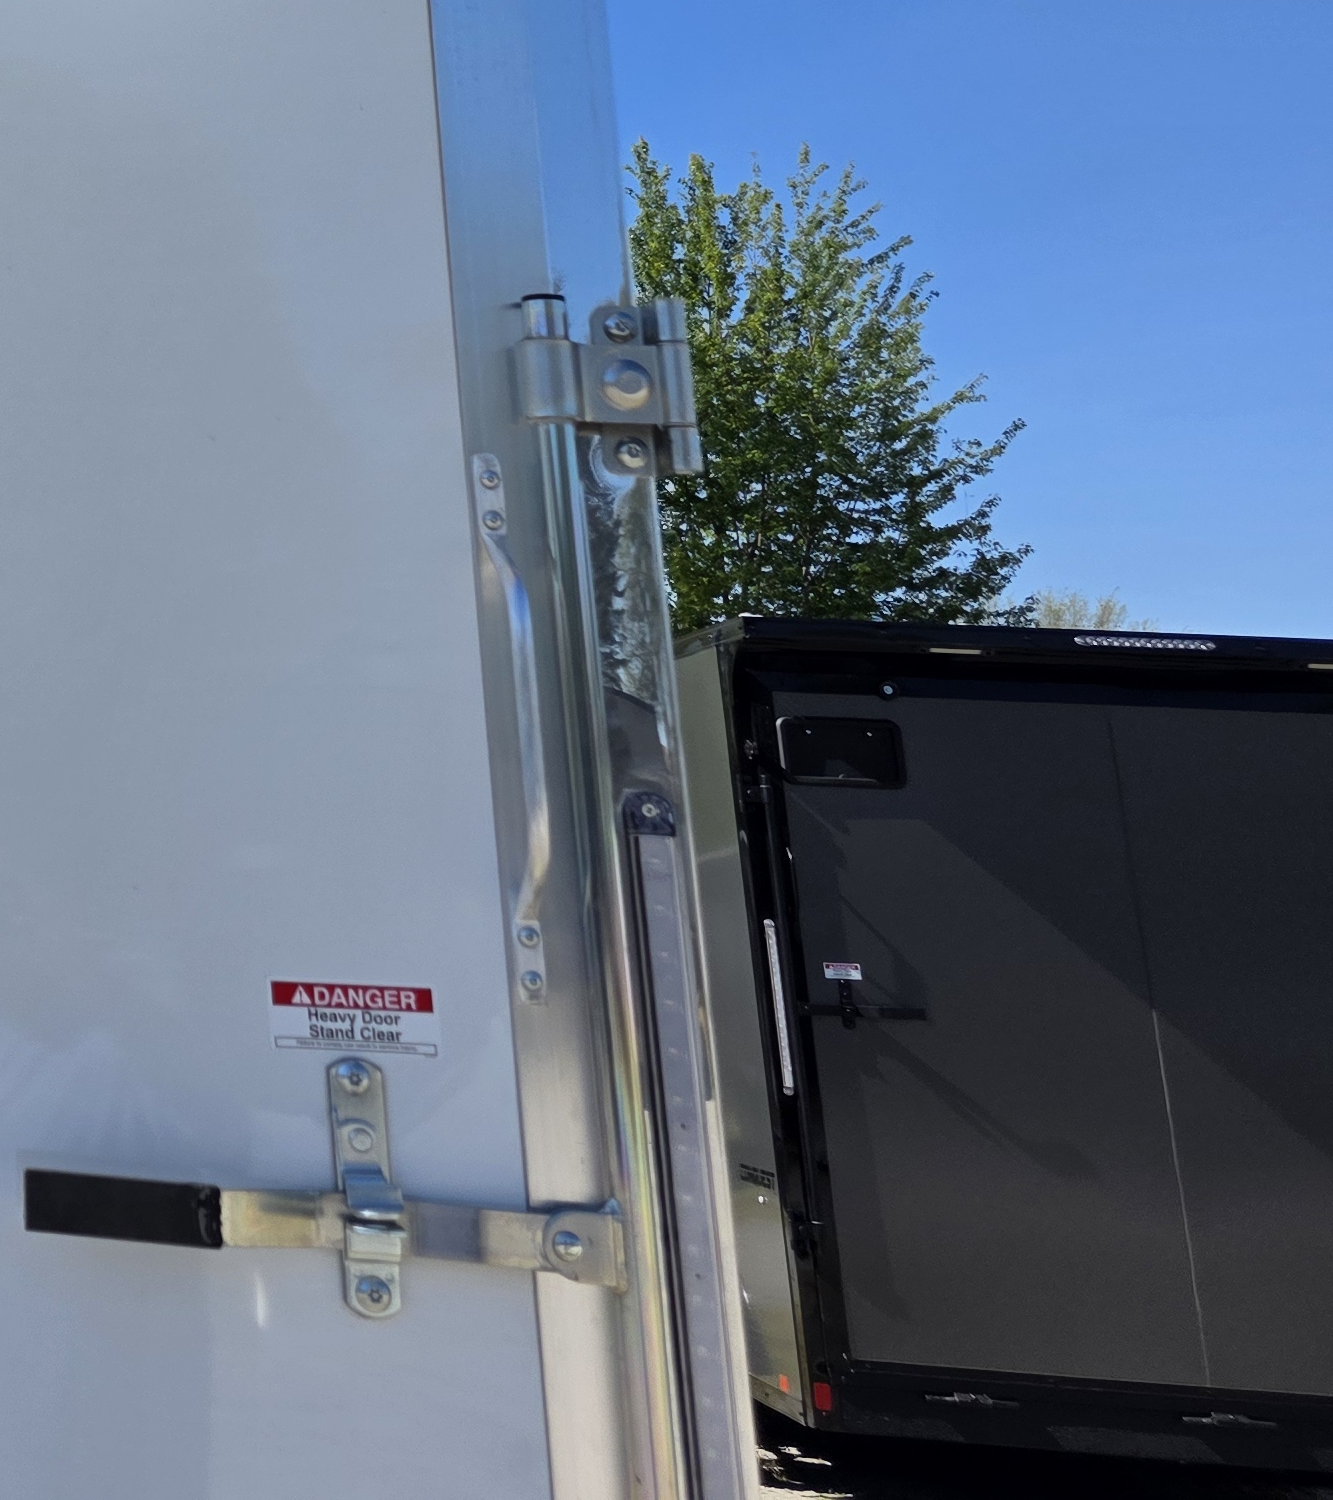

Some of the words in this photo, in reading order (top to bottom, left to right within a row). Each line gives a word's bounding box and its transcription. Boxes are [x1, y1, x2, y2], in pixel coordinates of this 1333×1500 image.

[313, 986, 417, 1010] DANGER
[308, 1007, 356, 1026] Heavy
[361, 1011, 401, 1025] Door
[309, 1024, 354, 1040] Stand
[360, 1026, 402, 1042] Clear
